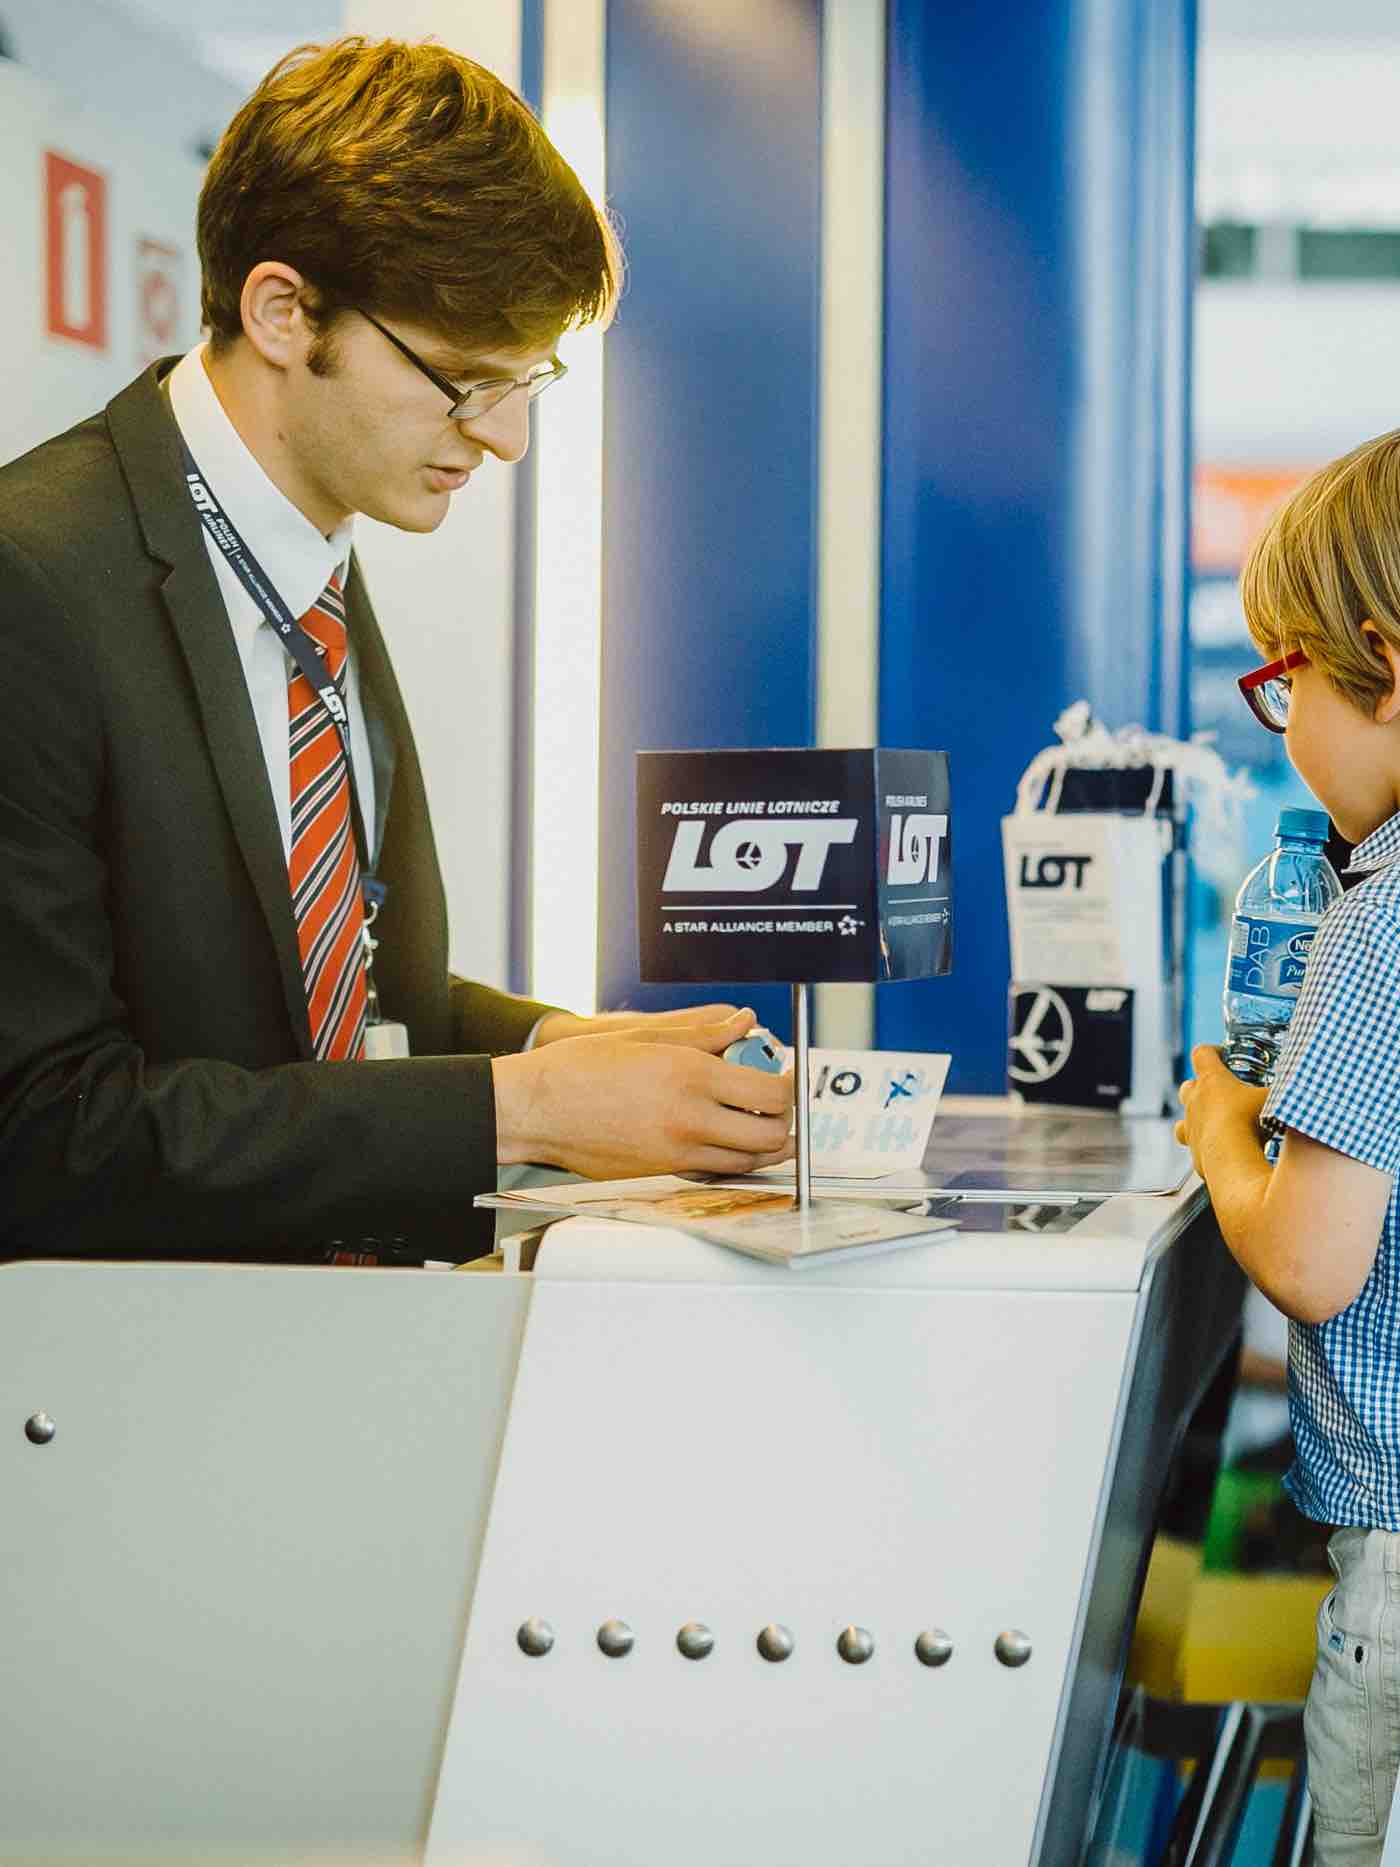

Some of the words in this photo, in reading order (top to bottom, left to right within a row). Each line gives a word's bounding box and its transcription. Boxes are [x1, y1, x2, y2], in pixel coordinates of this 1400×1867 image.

[186, 473, 219, 512] LOT
[202, 512, 232, 551] AIRLINES
[215, 517, 241, 549] POLISH
[660, 801, 723, 815] POLSKIE
[725, 800, 765, 815] LINIE
[767, 799, 841, 814] LOTNICZE
[661, 818, 859, 892] LOT
[887, 813, 948, 886] LOT
[1020, 854, 1092, 889] LOT
[663, 921, 674, 933] A
[674, 921, 707, 933] STAR
[709, 920, 774, 933] ALLIANCE
[776, 920, 834, 933] MEMBER
